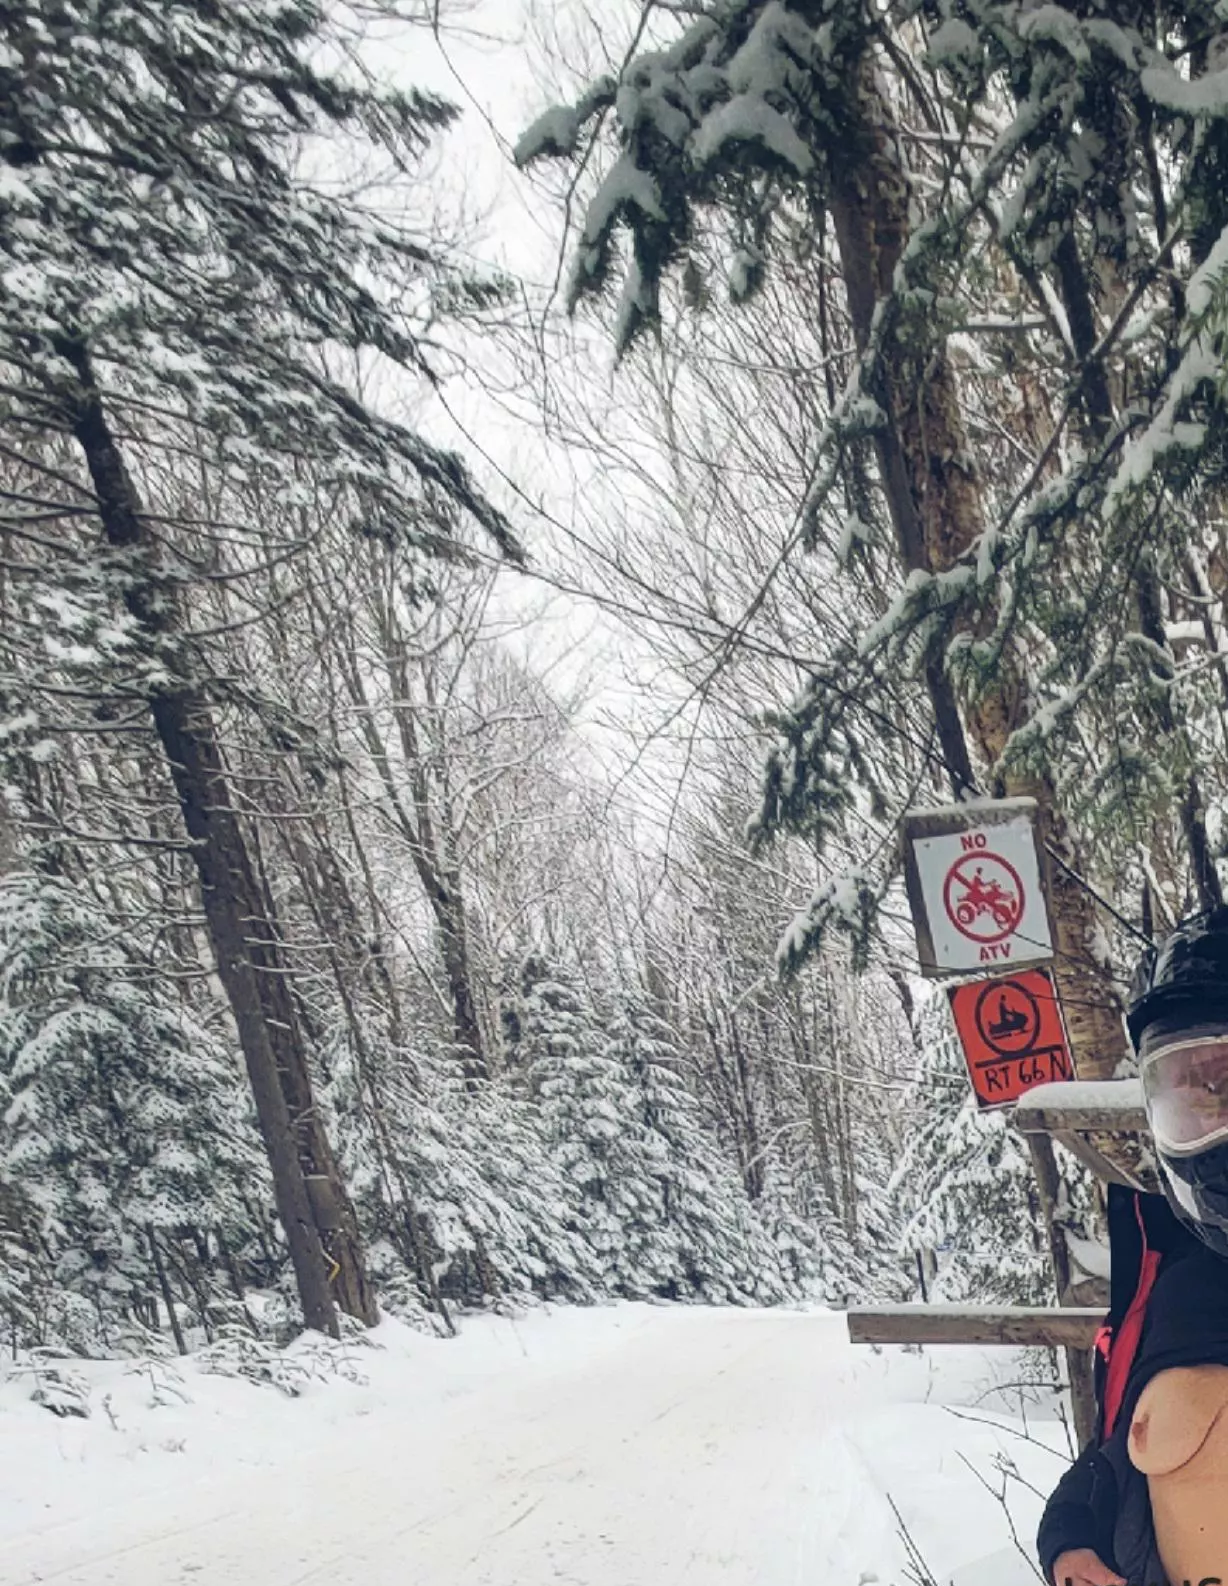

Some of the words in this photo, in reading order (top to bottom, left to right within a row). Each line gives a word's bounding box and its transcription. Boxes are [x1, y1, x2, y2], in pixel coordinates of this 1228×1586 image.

[960, 833, 988, 851] NO
[979, 944, 1012, 962] ATV
[984, 1065, 1011, 1093] RT
[1018, 1058, 1046, 1085] 66
[1049, 1050, 1067, 1082] N
